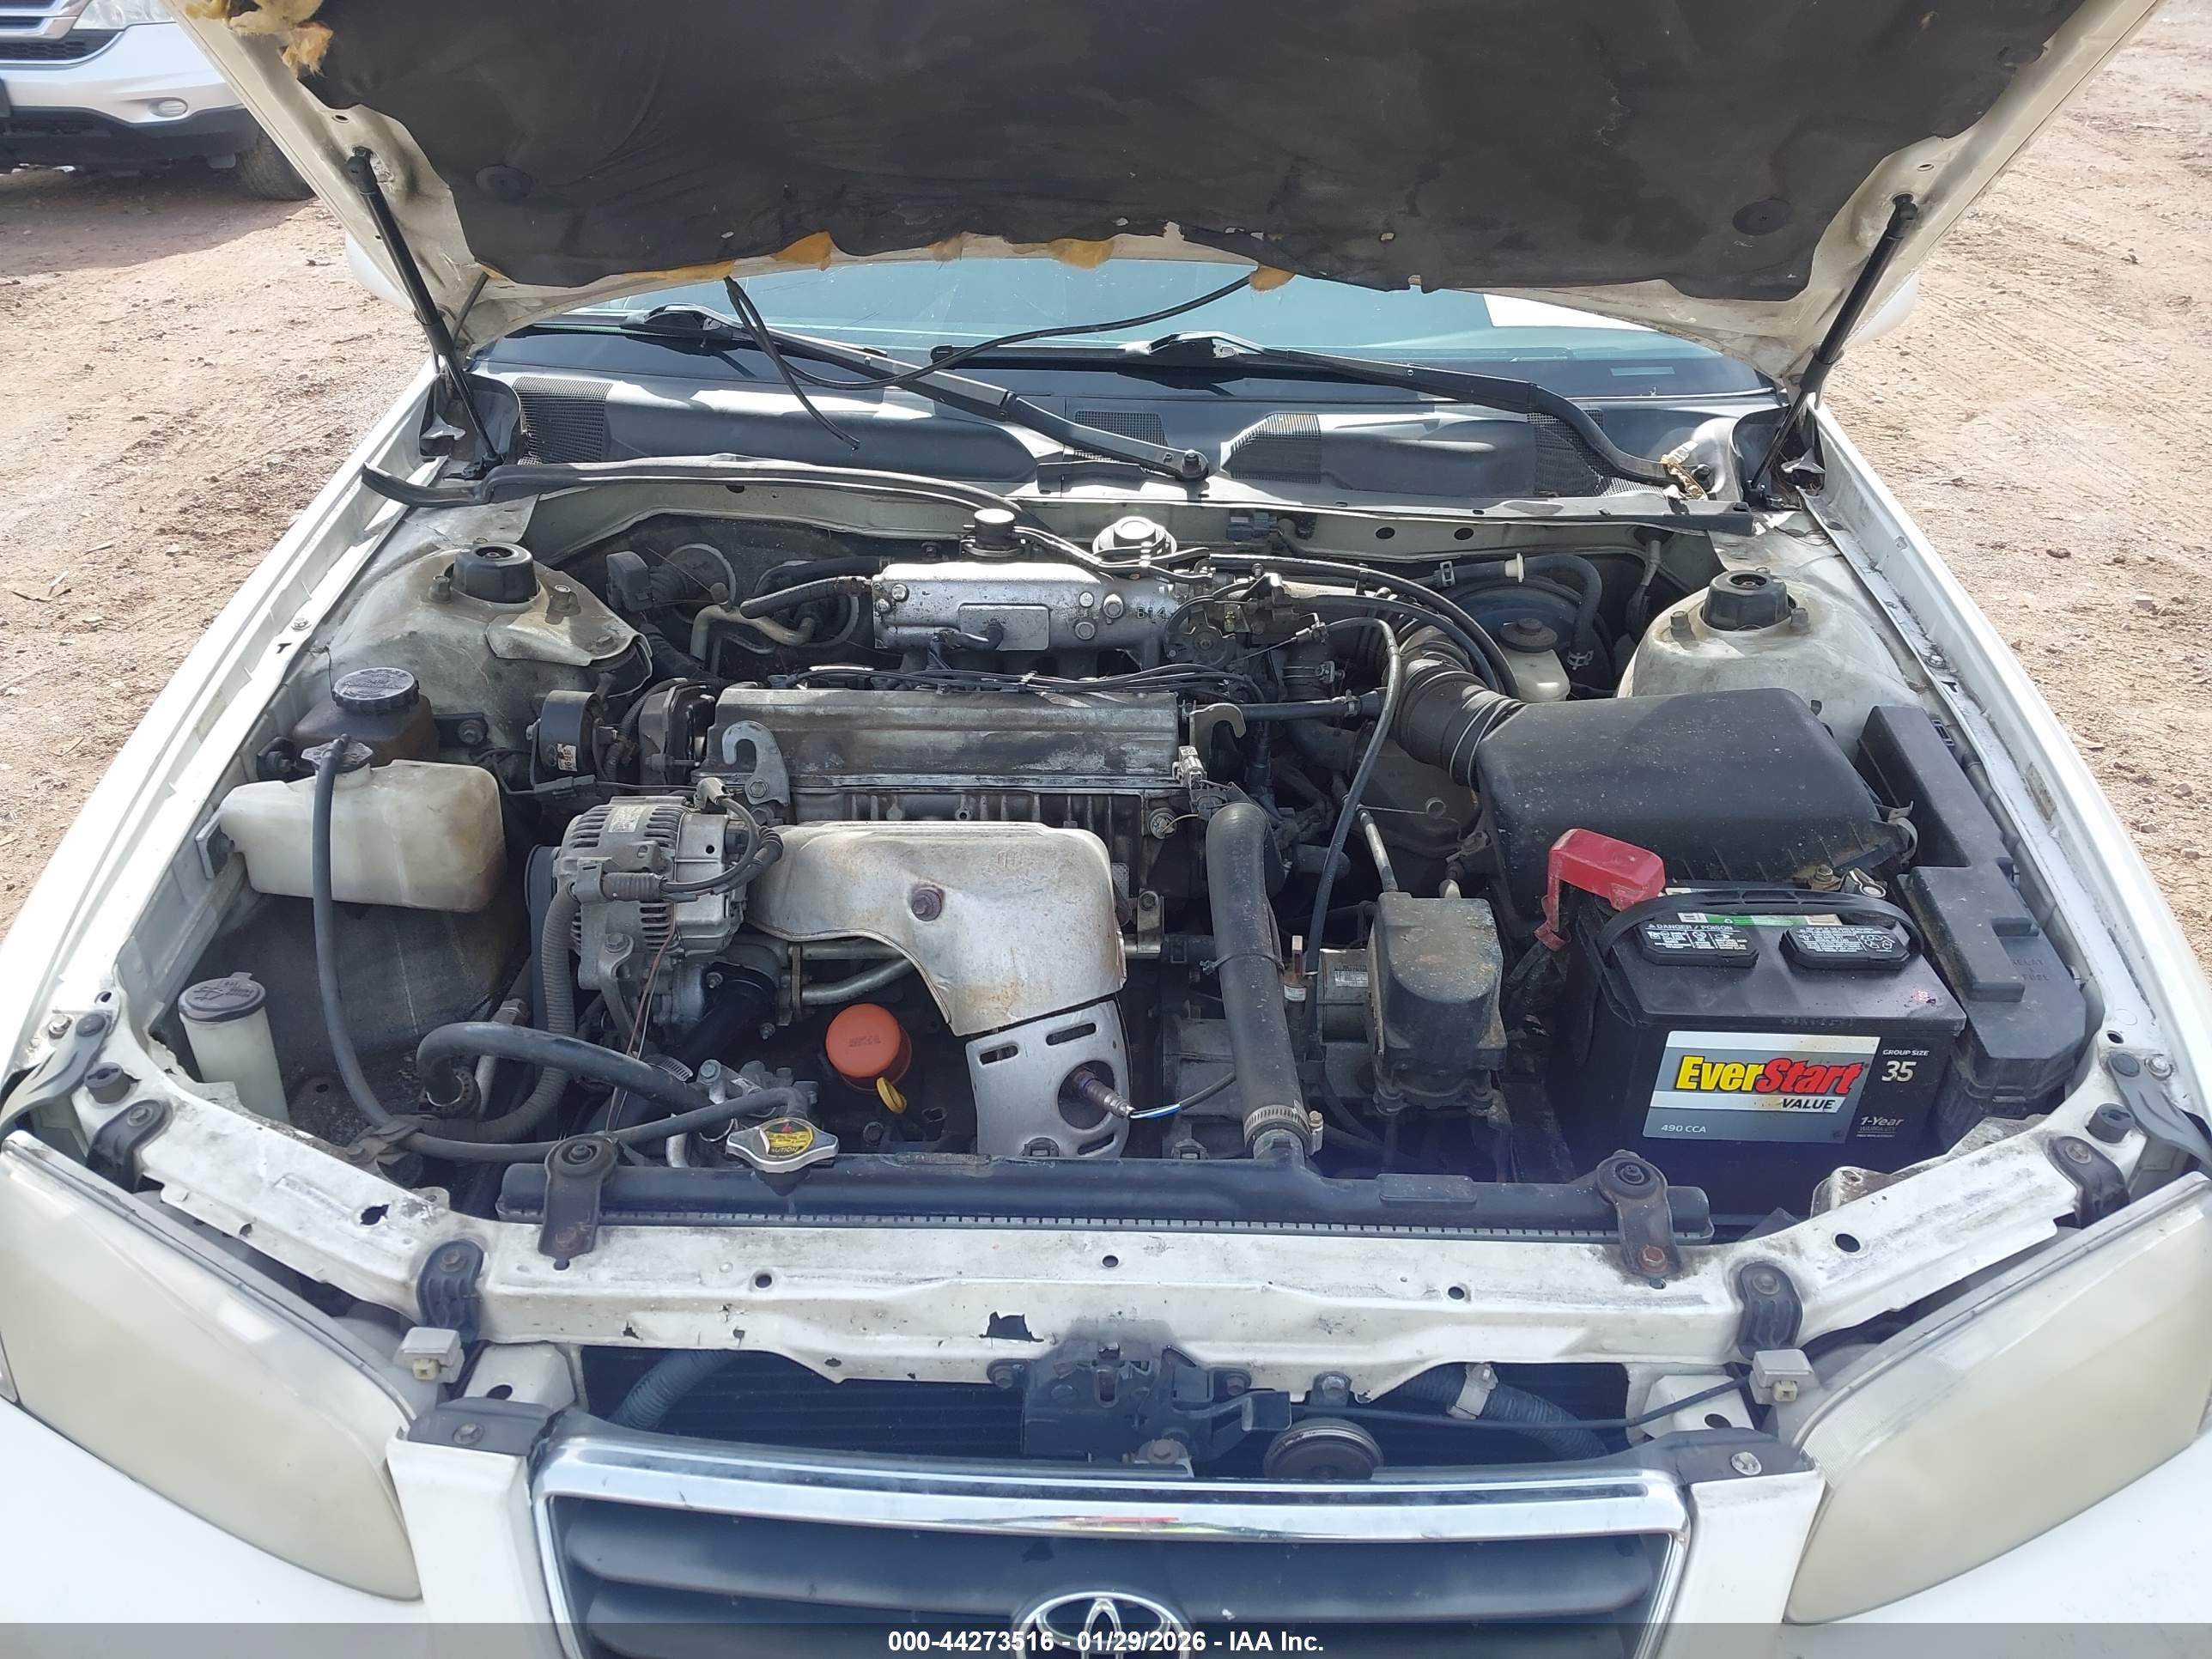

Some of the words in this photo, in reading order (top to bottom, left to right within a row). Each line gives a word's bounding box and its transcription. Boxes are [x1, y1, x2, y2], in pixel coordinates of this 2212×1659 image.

[1674, 1054, 1863, 1095] EverStart
[1881, 1060, 1917, 1082] 35
[1781, 1098, 1836, 1109] VALUE
[1861, 1116, 1905, 1126] 1-Year
[1661, 1124, 1683, 1133] 490
[1685, 1125, 1707, 1133] CCA
